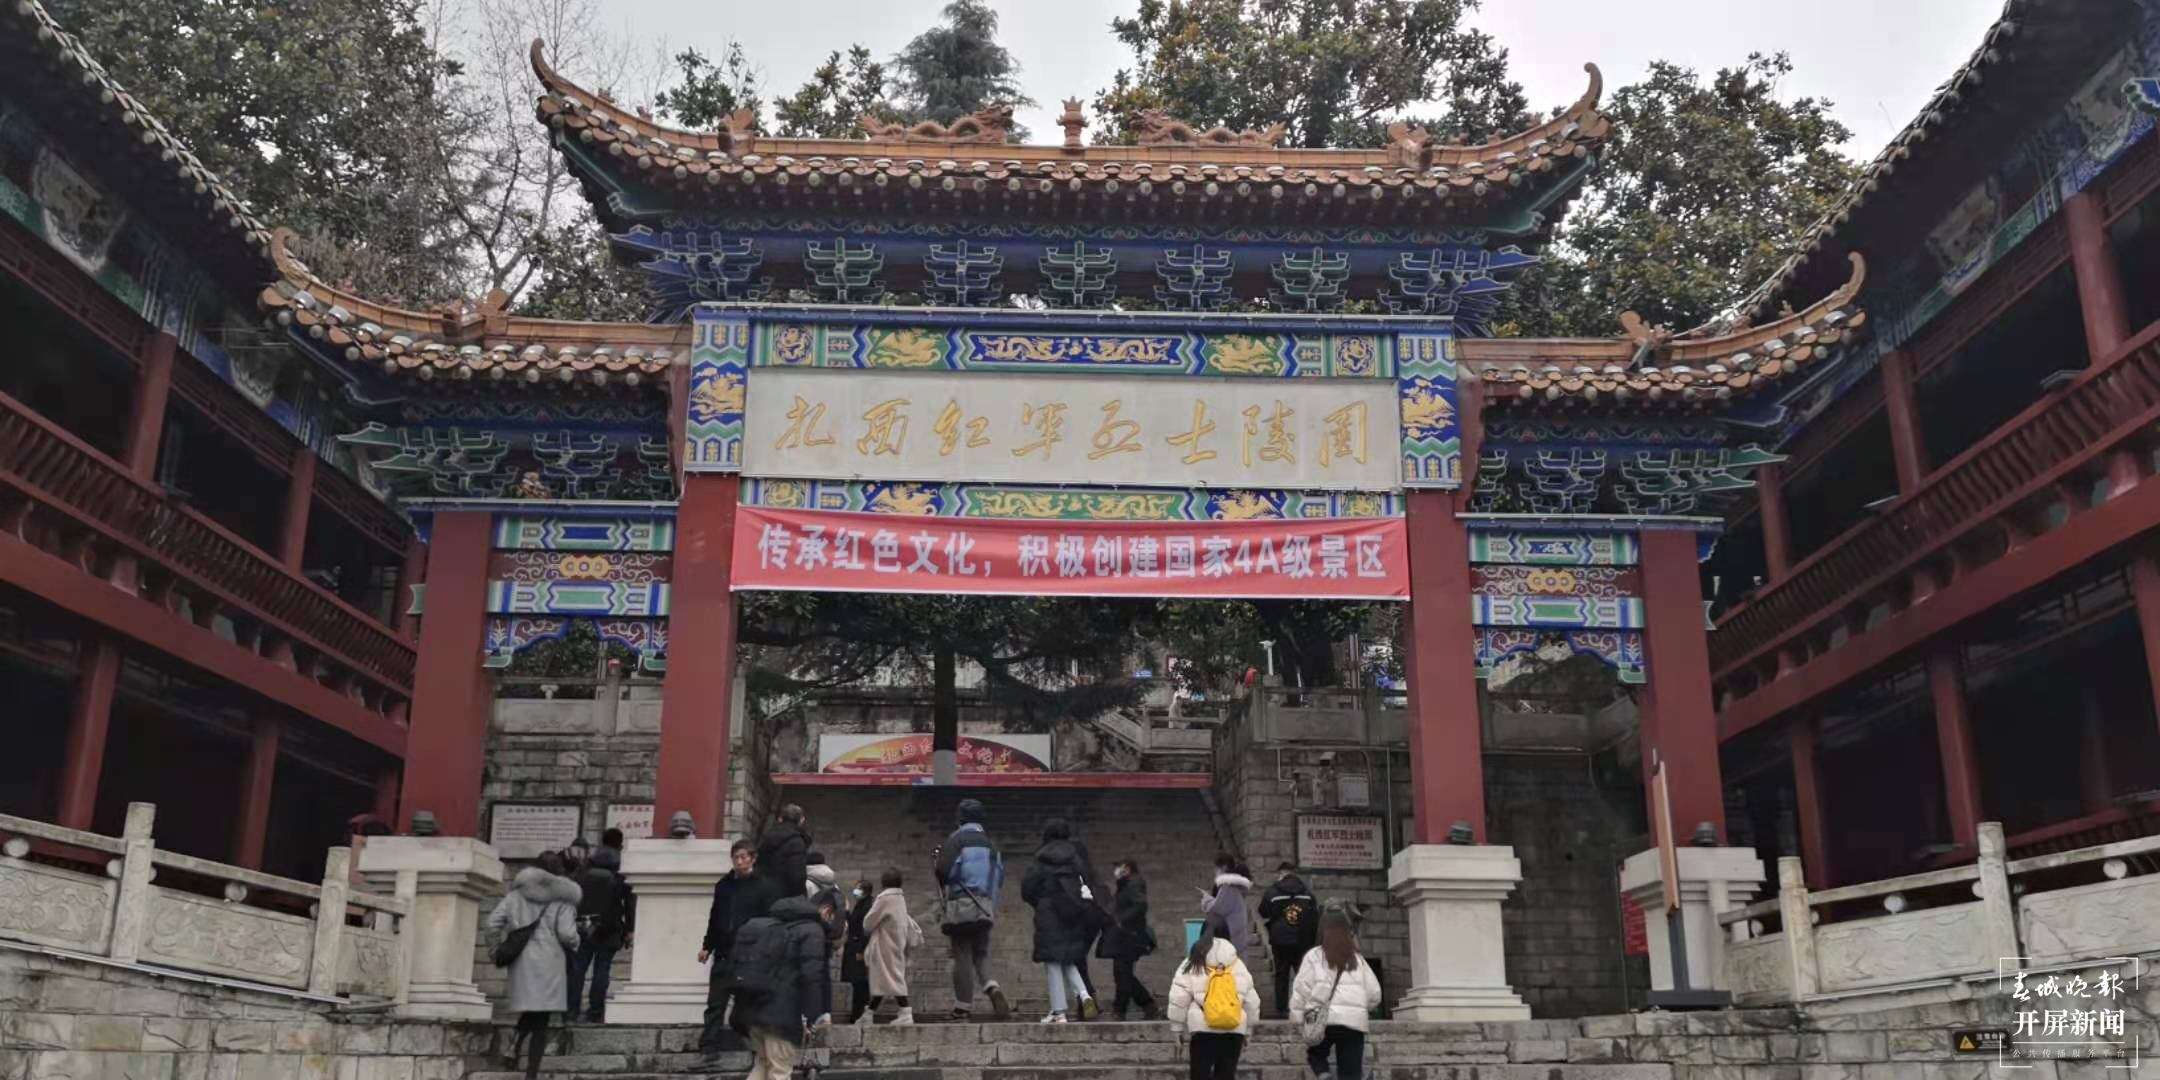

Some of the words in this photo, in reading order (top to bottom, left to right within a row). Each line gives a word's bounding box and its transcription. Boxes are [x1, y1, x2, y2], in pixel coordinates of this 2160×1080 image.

[757, 522, 1387, 578] 传承红色文化，积极创建国家4A级景区
